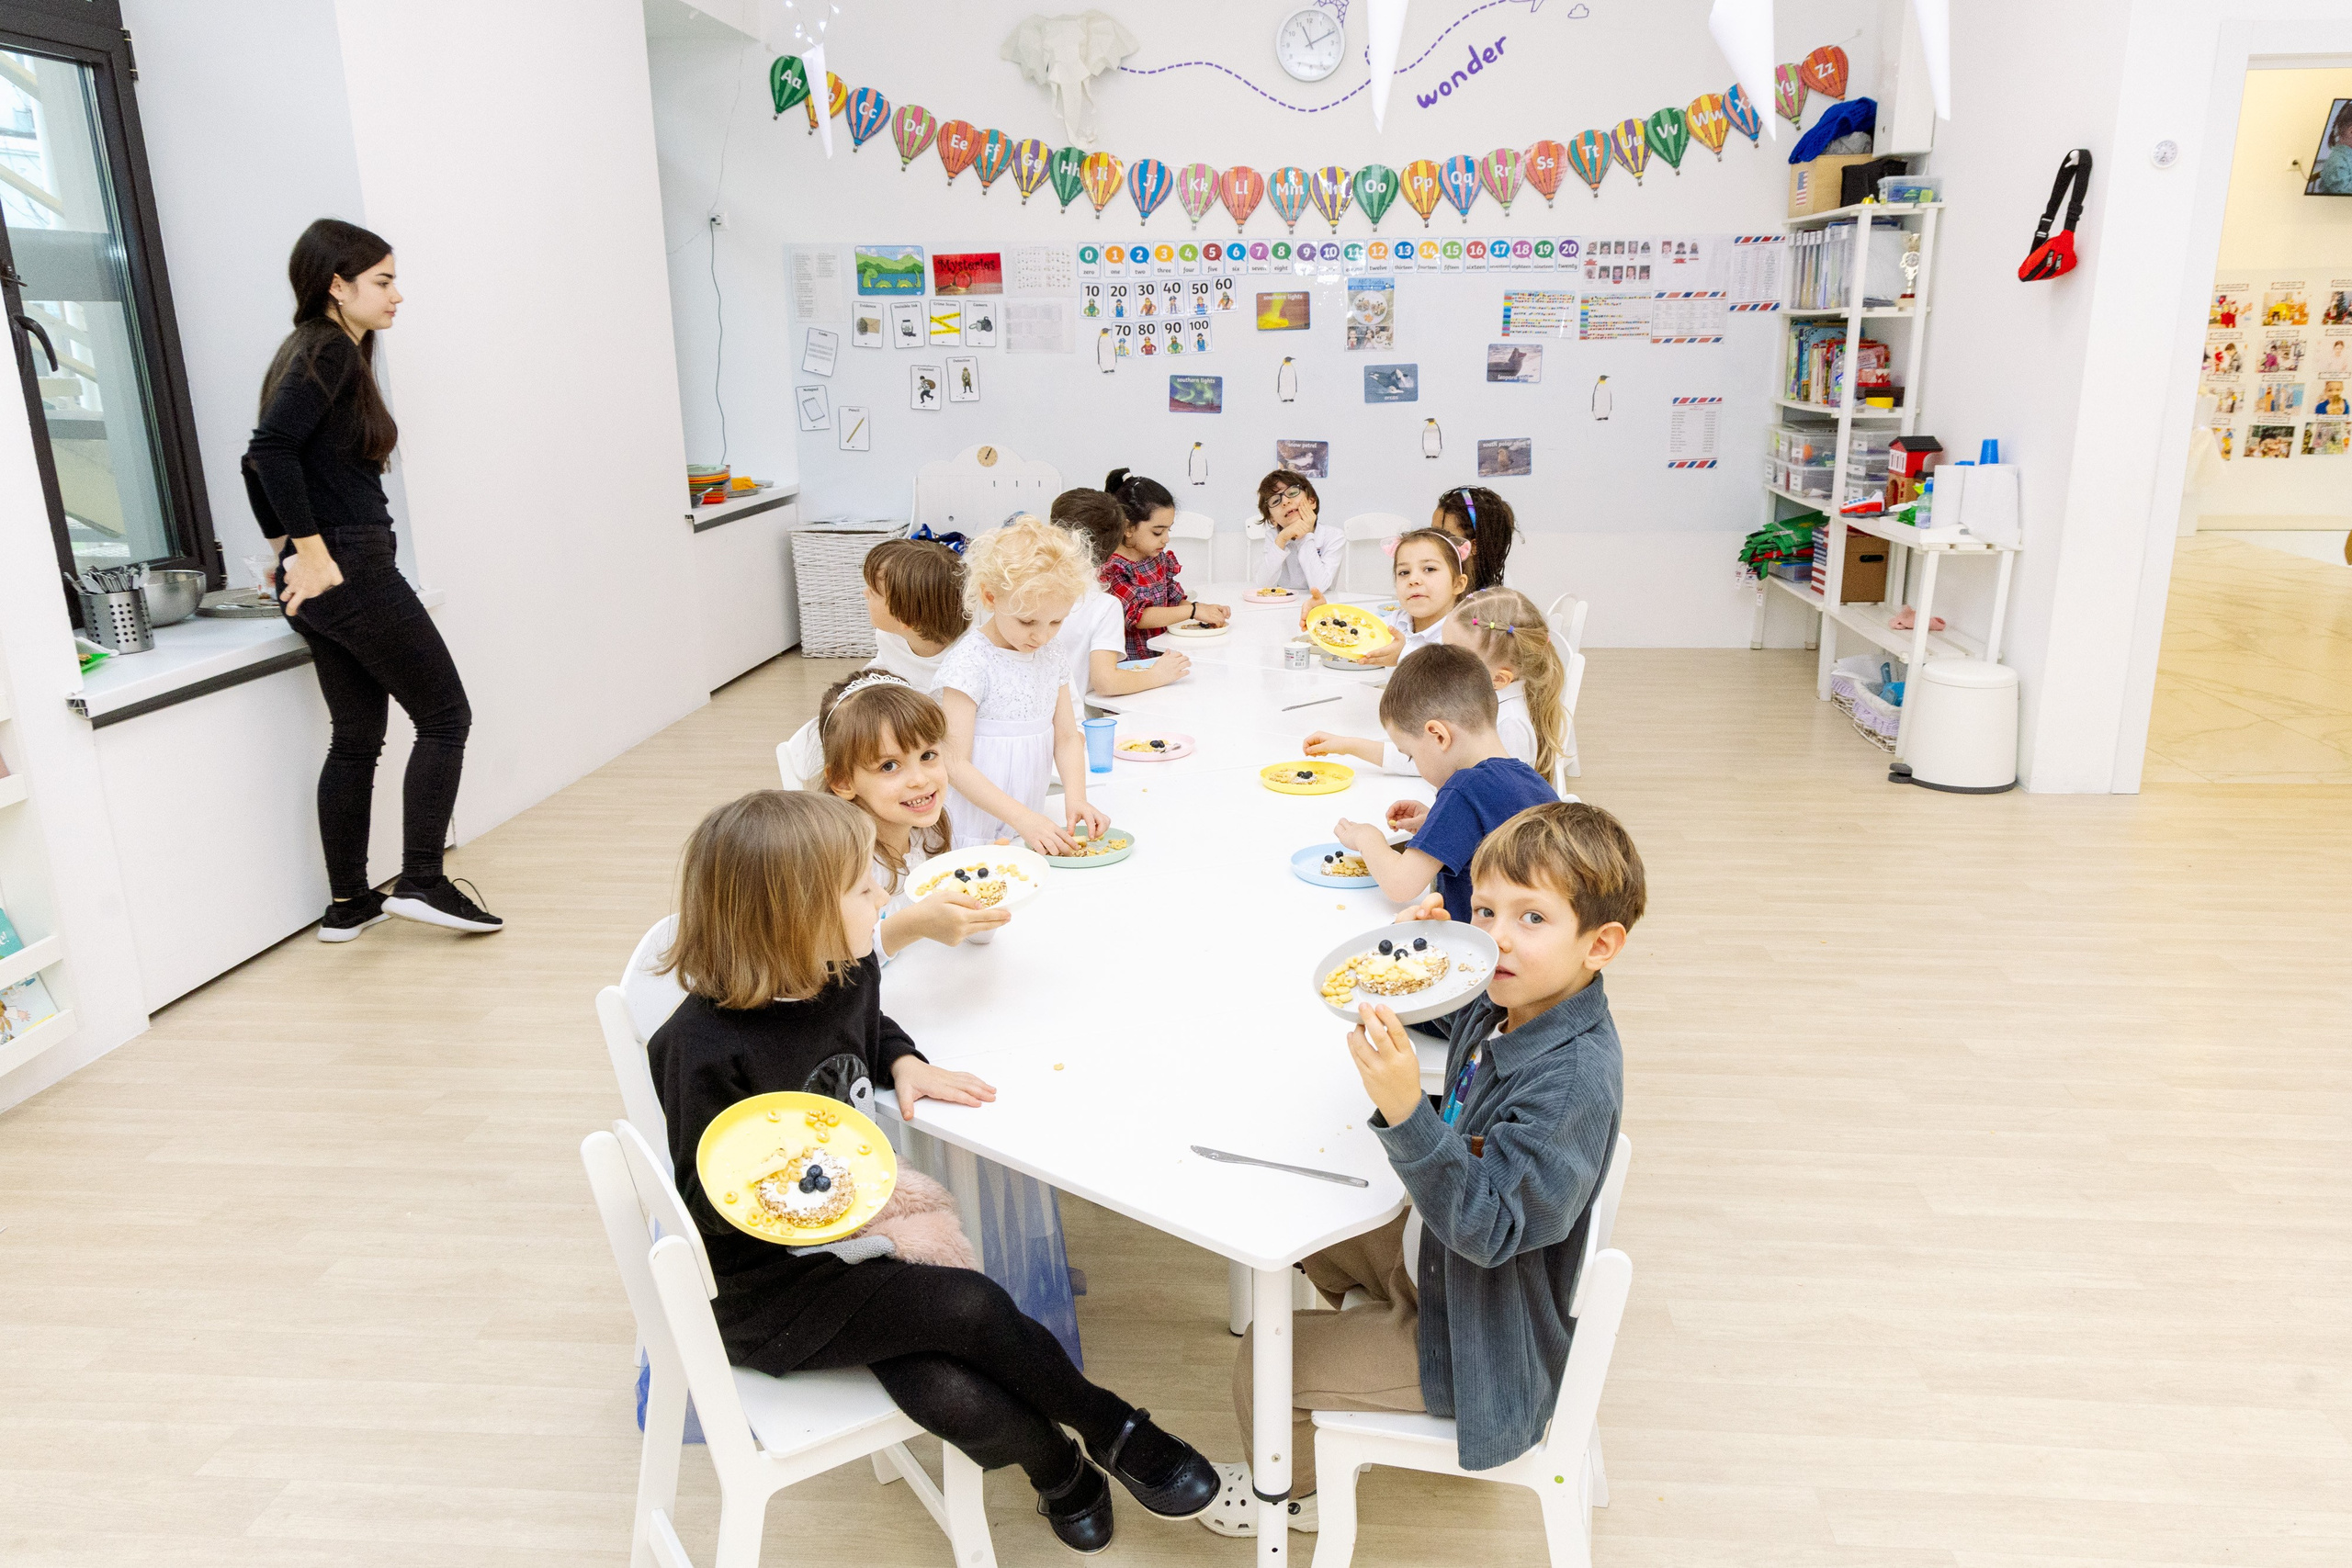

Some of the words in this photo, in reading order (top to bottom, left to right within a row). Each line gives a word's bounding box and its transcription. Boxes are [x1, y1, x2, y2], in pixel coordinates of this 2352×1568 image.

[1417, 36, 1507, 108] wonder
[1815, 62, 1836, 80] Zz
[781, 69, 802, 89] Aa
[1775, 79, 1796, 96] Yy
[858, 101, 877, 118] Cc
[1692, 109, 1724, 128] Ww
[904, 118, 924, 137] Dd
[1656, 123, 1679, 139] Vv
[949, 133, 968, 151] Ee
[1621, 134, 1644, 150] Uu
[985, 143, 1001, 163] Ff
[1581, 144, 1600, 160] Tt
[1022, 152, 1044, 173] Gg
[1060, 161, 1080, 176] Hh
[1536, 155, 1555, 170] Ss
[1096, 166, 1108, 181] Ii
[1493, 164, 1512, 178] Rr
[1143, 174, 1158, 193] Jj
[1412, 175, 1433, 193] Pp
[1450, 171, 1475, 186] Qq
[1189, 177, 1208, 193] Kk
[1235, 179, 1249, 195] Ll
[1276, 183, 1305, 196] Mm
[1364, 179, 1387, 194] Oo
[1160, 248, 1168, 259] 3
[1184, 248, 1193, 259] 4
[1208, 247, 1216, 258] 5
[1232, 247, 1240, 258] 6
[1255, 246, 1263, 257] 7
[1277, 246, 1285, 256] 8
[1303, 247, 1311, 258] 9
[1323, 246, 1338, 258] 10
[1372, 246, 1385, 256] 12
[1397, 245, 1411, 256] 13
[1422, 244, 1435, 255] 14
[1445, 244, 1460, 256] 15
[1470, 244, 1484, 255] 16
[1493, 244, 1508, 255] 17
[1515, 244, 1530, 255] 18
[1537, 244, 1552, 255] 19
[1562, 243, 1577, 254] 20
[1085, 250, 1093, 261] 0
[1112, 250, 1119, 261] 1
[1136, 249, 1144, 261] 2
[937, 258, 996, 274] Mysteries
[1137, 284, 1155, 295] 30
[1163, 282, 1182, 294] 40
[1192, 283, 1209, 294] 50
[1215, 278, 1233, 290] 60
[1085, 286, 1100, 297] 10
[1110, 286, 1127, 298] 20
[1287, 293, 1303, 301] lights
[1114, 325, 1132, 336] 70
[1137, 323, 1156, 335] 80
[1164, 322, 1182, 334] 90
[1190, 321, 1209, 331] 100
